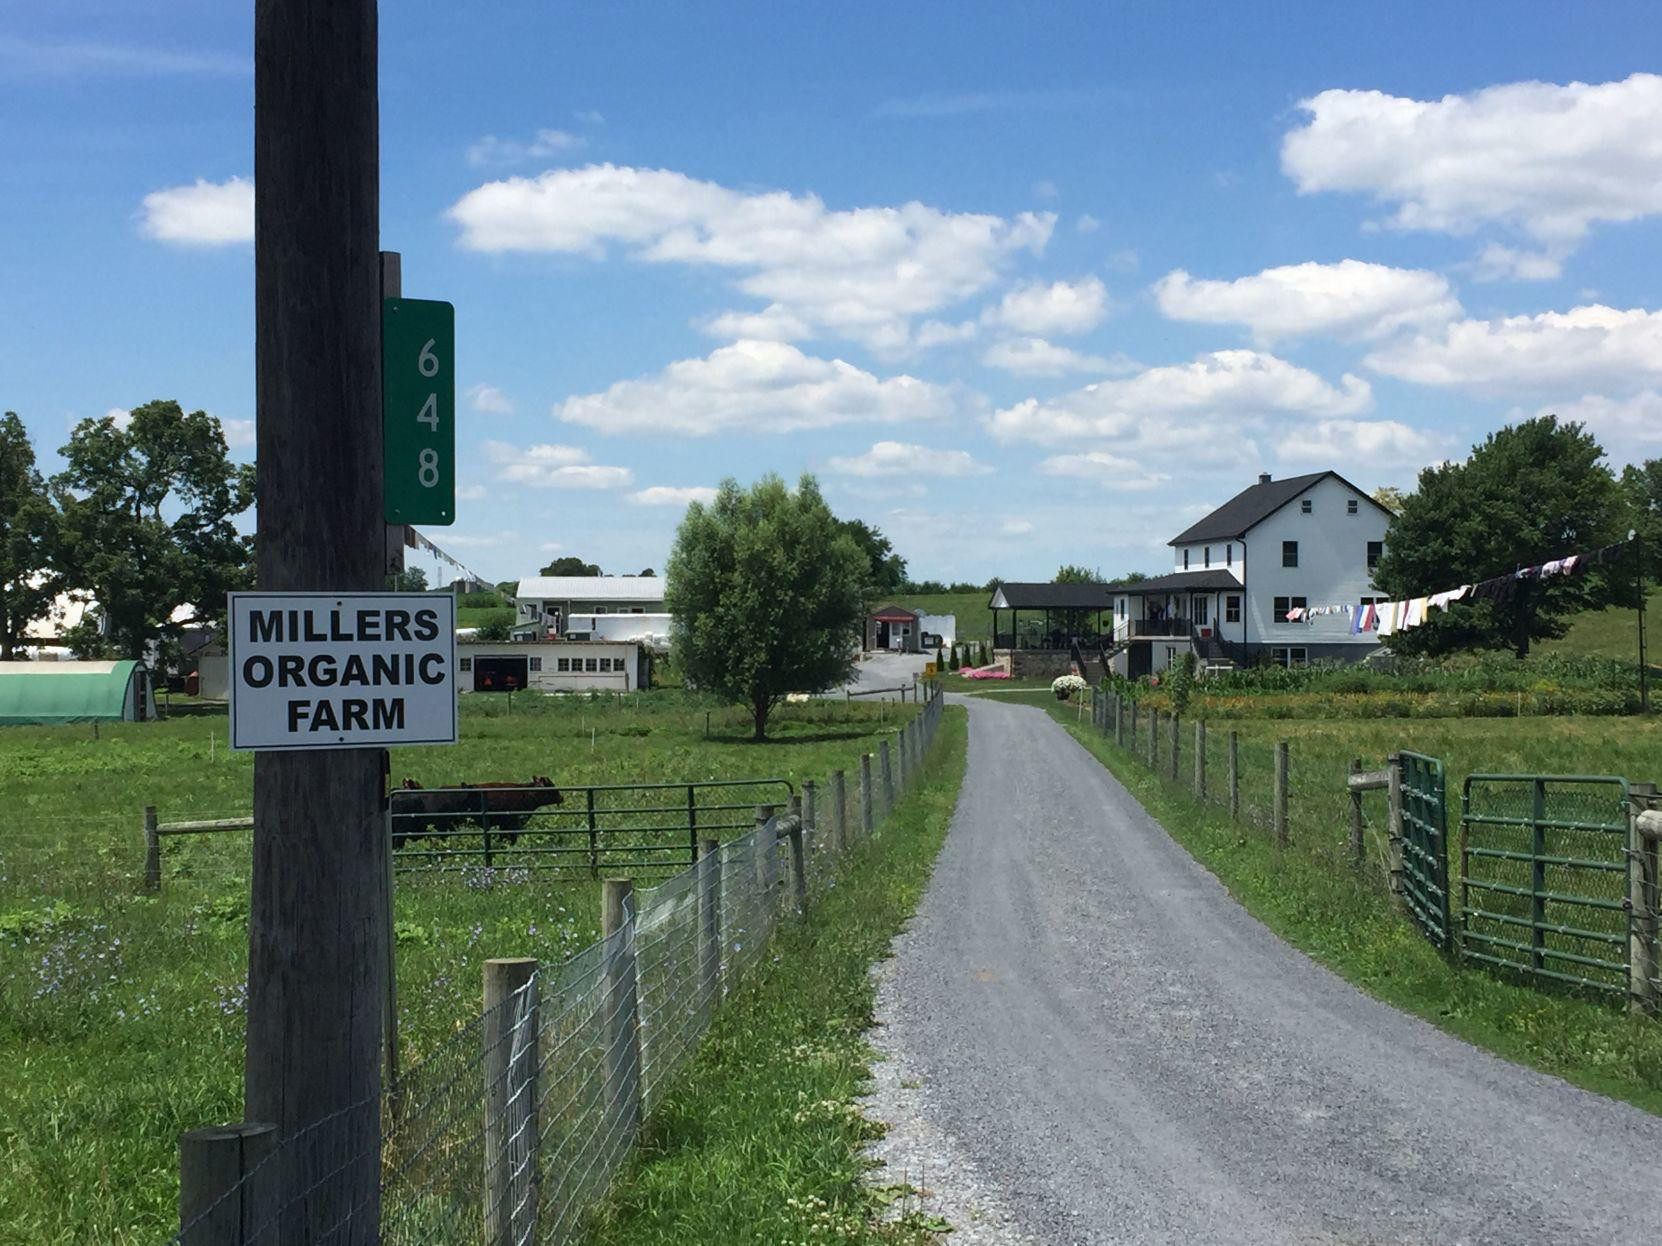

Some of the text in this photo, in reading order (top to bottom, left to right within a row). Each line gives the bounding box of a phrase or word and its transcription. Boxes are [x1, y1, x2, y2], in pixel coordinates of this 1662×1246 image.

[416, 338, 440, 488] 648
[249, 609, 439, 643] MILLERS
[243, 653, 446, 688] ORGANIC
[287, 698, 405, 732] FARM
